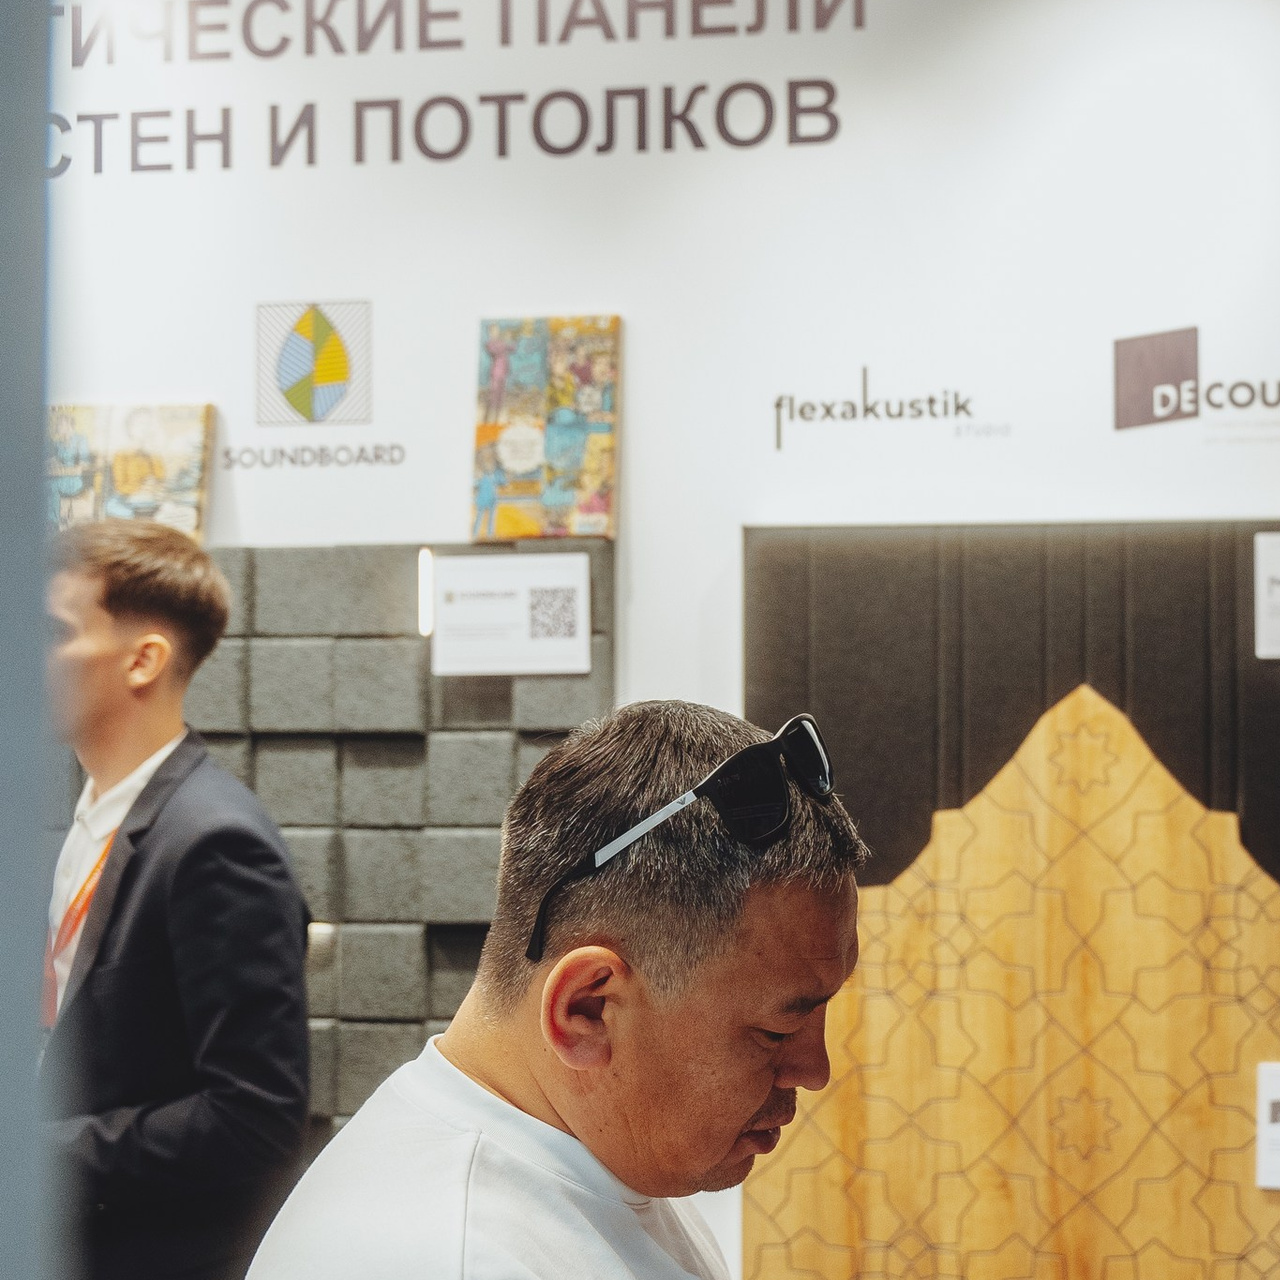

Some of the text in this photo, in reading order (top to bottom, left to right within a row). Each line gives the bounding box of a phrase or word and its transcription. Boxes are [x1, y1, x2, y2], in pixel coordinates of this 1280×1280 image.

[270, 103, 316, 168] И
[353, 78, 841, 164] ПОТОЛКОВ
[775, 365, 973, 450] flexakustik
[223, 441, 406, 471] SOUNDBOARD
